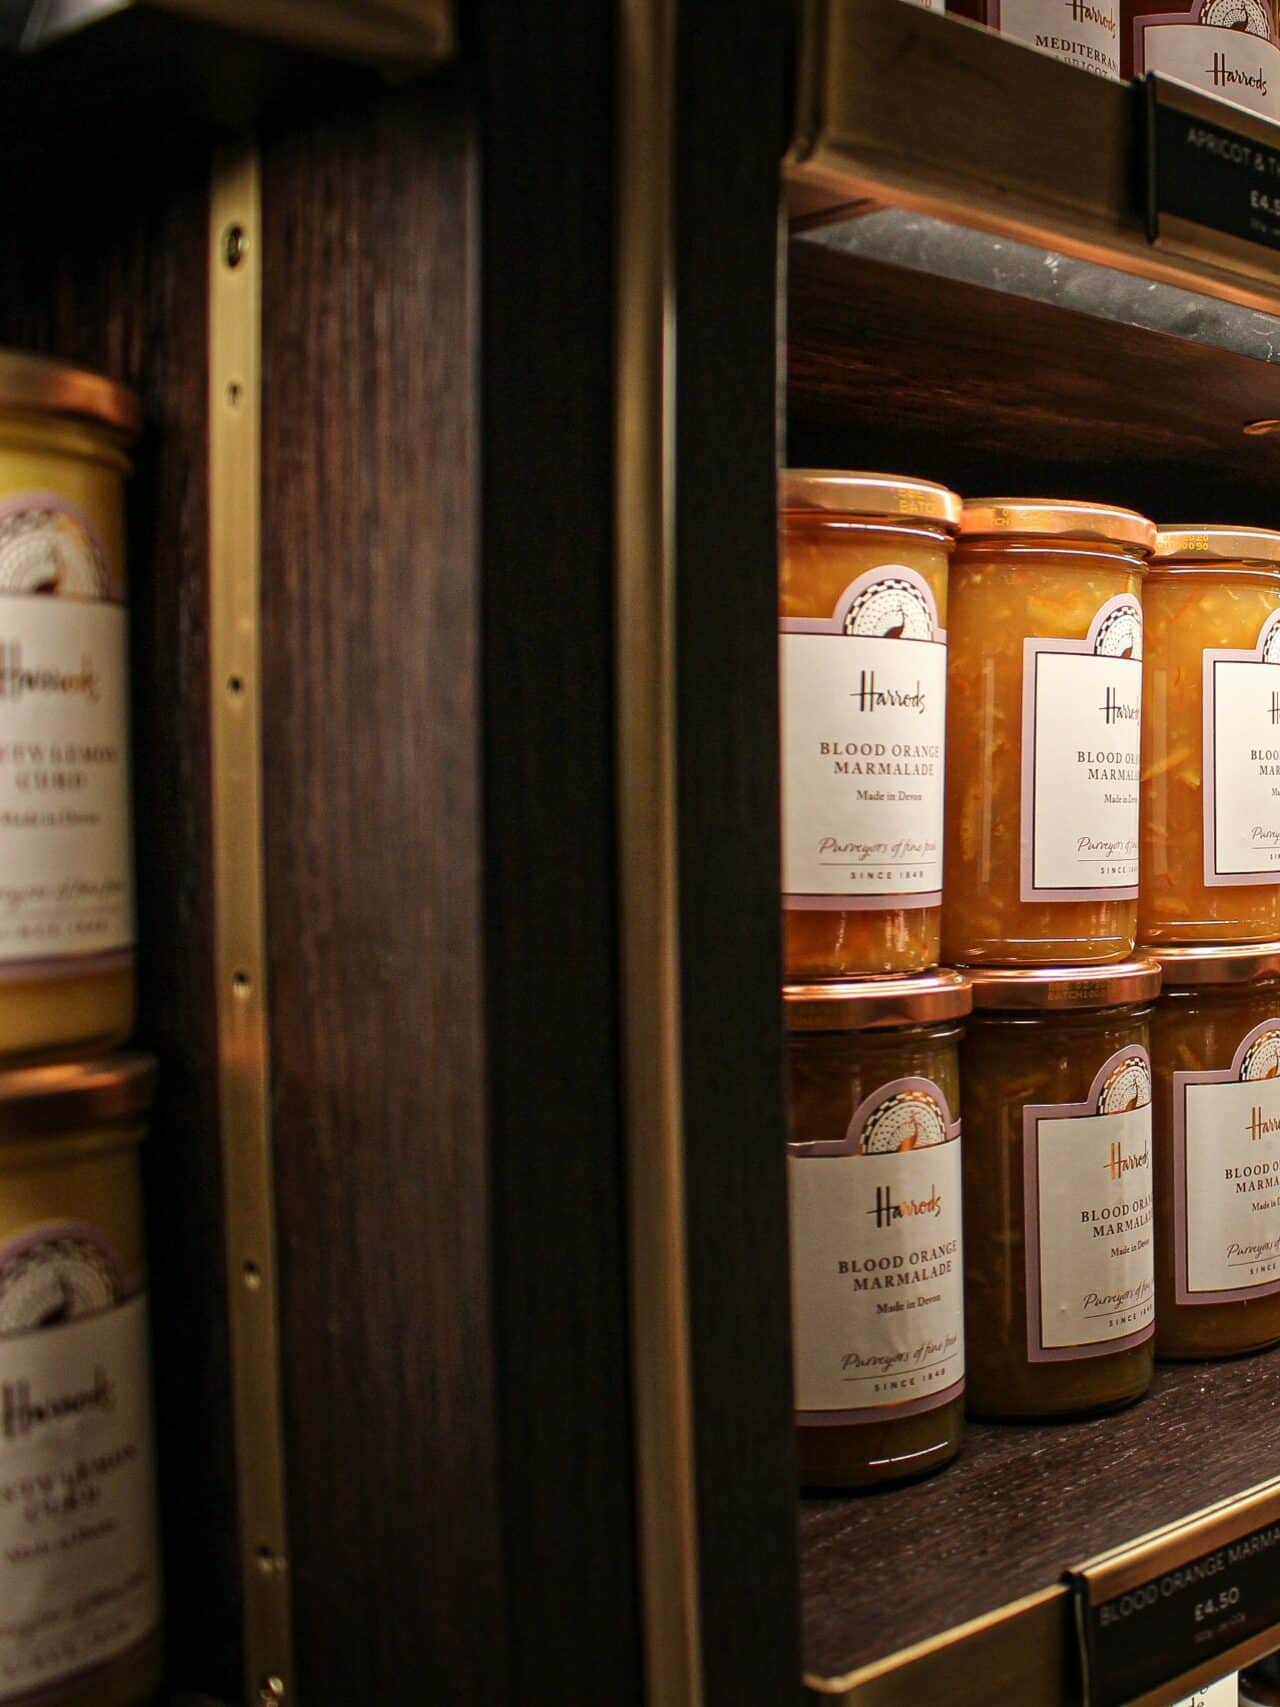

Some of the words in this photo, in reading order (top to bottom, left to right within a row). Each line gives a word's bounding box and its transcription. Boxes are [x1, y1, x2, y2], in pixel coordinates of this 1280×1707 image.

[1065, 0, 1116, 39] Harrods
[1205, 52, 1267, 97] Harrods
[1187, 127, 1250, 166] APRICOT
[1254, 152, 1265, 172] &
[849, 669, 925, 714] Harrods
[820, 742, 886, 756] BLOOD
[891, 743, 939, 758] ORANGE
[1077, 750, 1123, 764] BLOOD
[833, 761, 935, 776] MARMALADE
[856, 789, 884, 801] Made
[887, 790, 896, 801] in
[850, 871, 892, 880] SINCE
[1100, 866, 1126, 874] SINCE
[1225, 1163, 1270, 1180] BLOOD
[866, 1184, 942, 1229] Harrods
[1081, 1204, 1130, 1223] BLOOD
[1252, 1199, 1270, 1213] Made
[838, 1255, 903, 1274] BLOOD
[909, 1239, 957, 1266] ORANGE
[1111, 1243, 1131, 1258] Made
[853, 1259, 952, 1292] MARMALADE
[1250, 1263, 1276, 1275] SINCE
[876, 1302, 904, 1315] Made
[906, 1301, 916, 1310] in
[1109, 1313, 1137, 1328] SINCE
[841, 1350, 910, 1373] Purveyors
[874, 1377, 915, 1392] SINCE
[1100, 1586, 1159, 1627] BLOOD
[1161, 1553, 1225, 1597] ORANGE
[1195, 1587, 1239, 1622] £4.50
